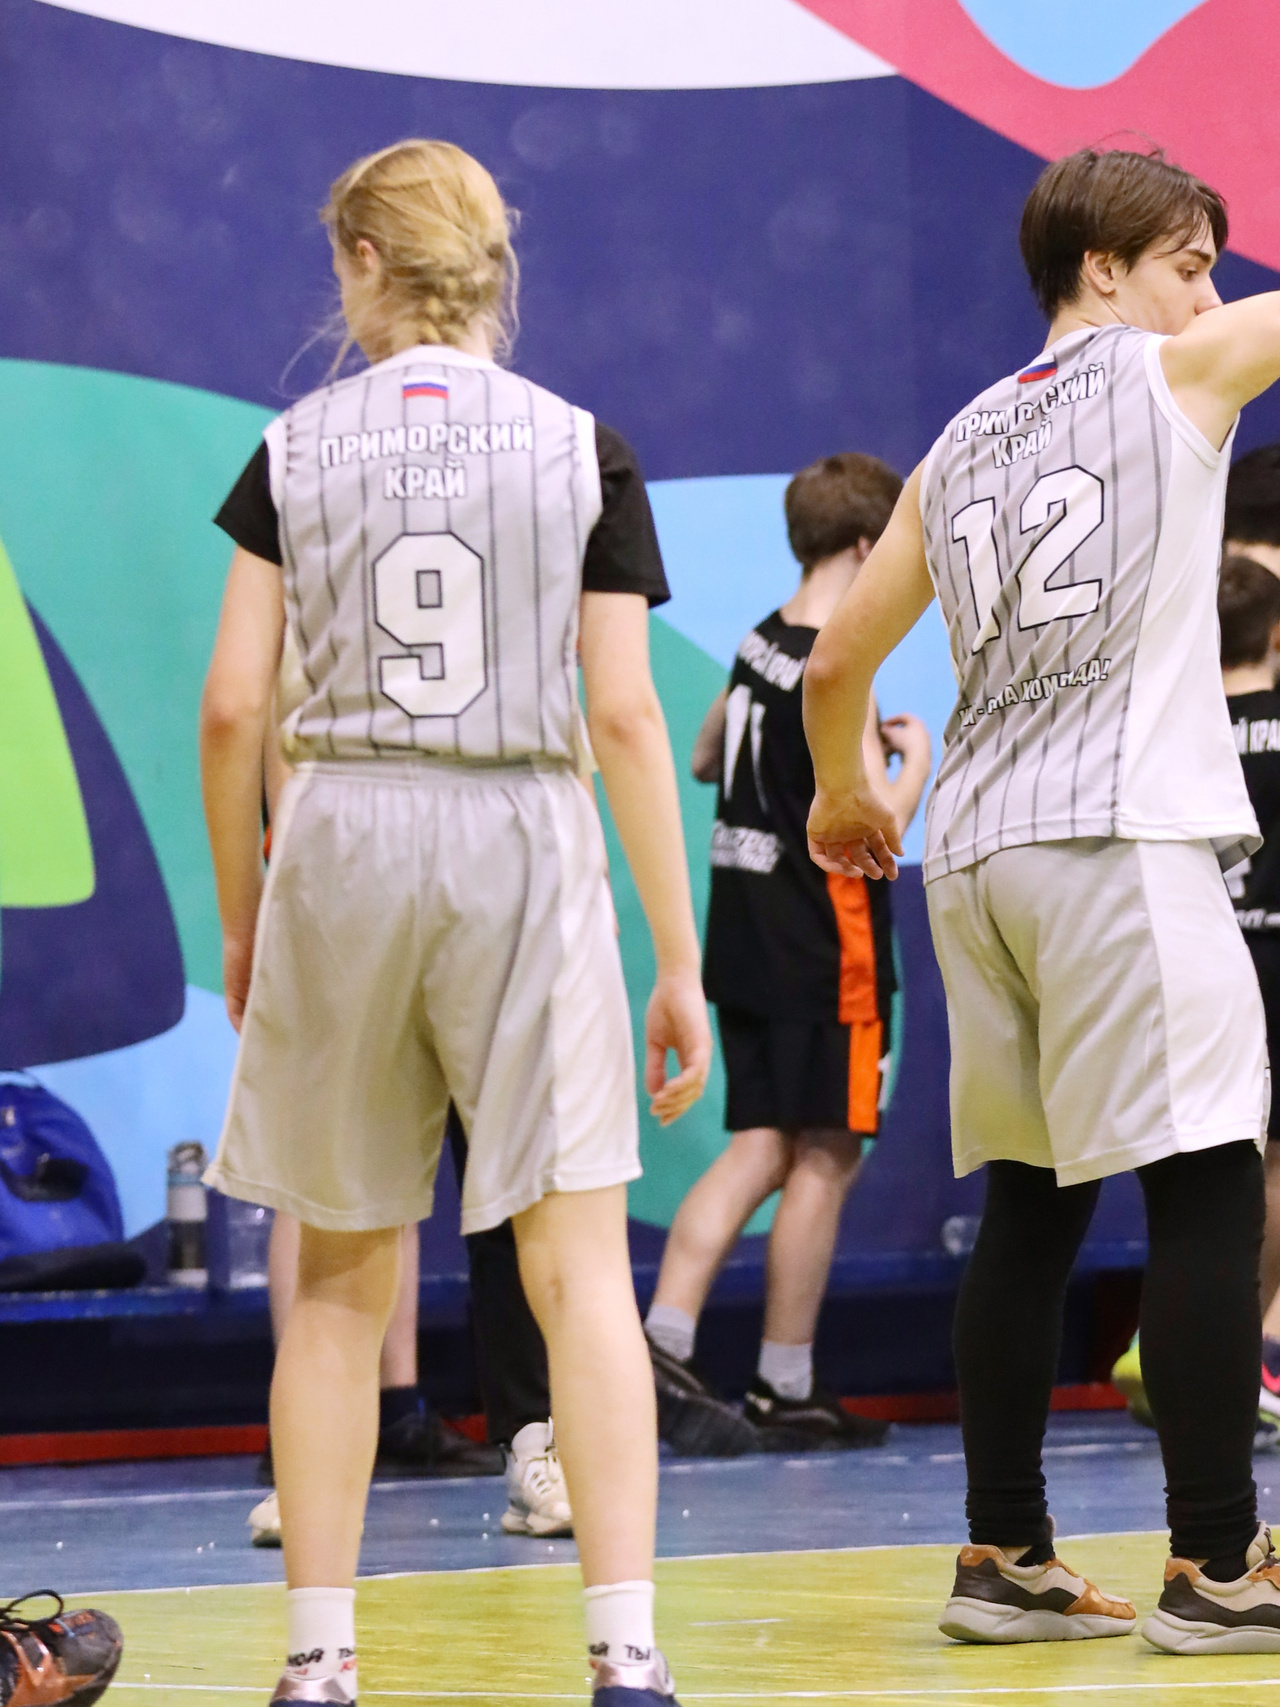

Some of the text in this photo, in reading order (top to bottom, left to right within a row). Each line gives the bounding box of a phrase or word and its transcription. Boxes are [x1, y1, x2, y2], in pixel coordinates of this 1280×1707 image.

[320, 417, 534, 468] ПРИМОРСКИЙ
[992, 418, 1053, 468] КРАЙ
[383, 460, 468, 499] КРАЙ
[951, 465, 1104, 656] 12
[372, 531, 489, 718] 9
